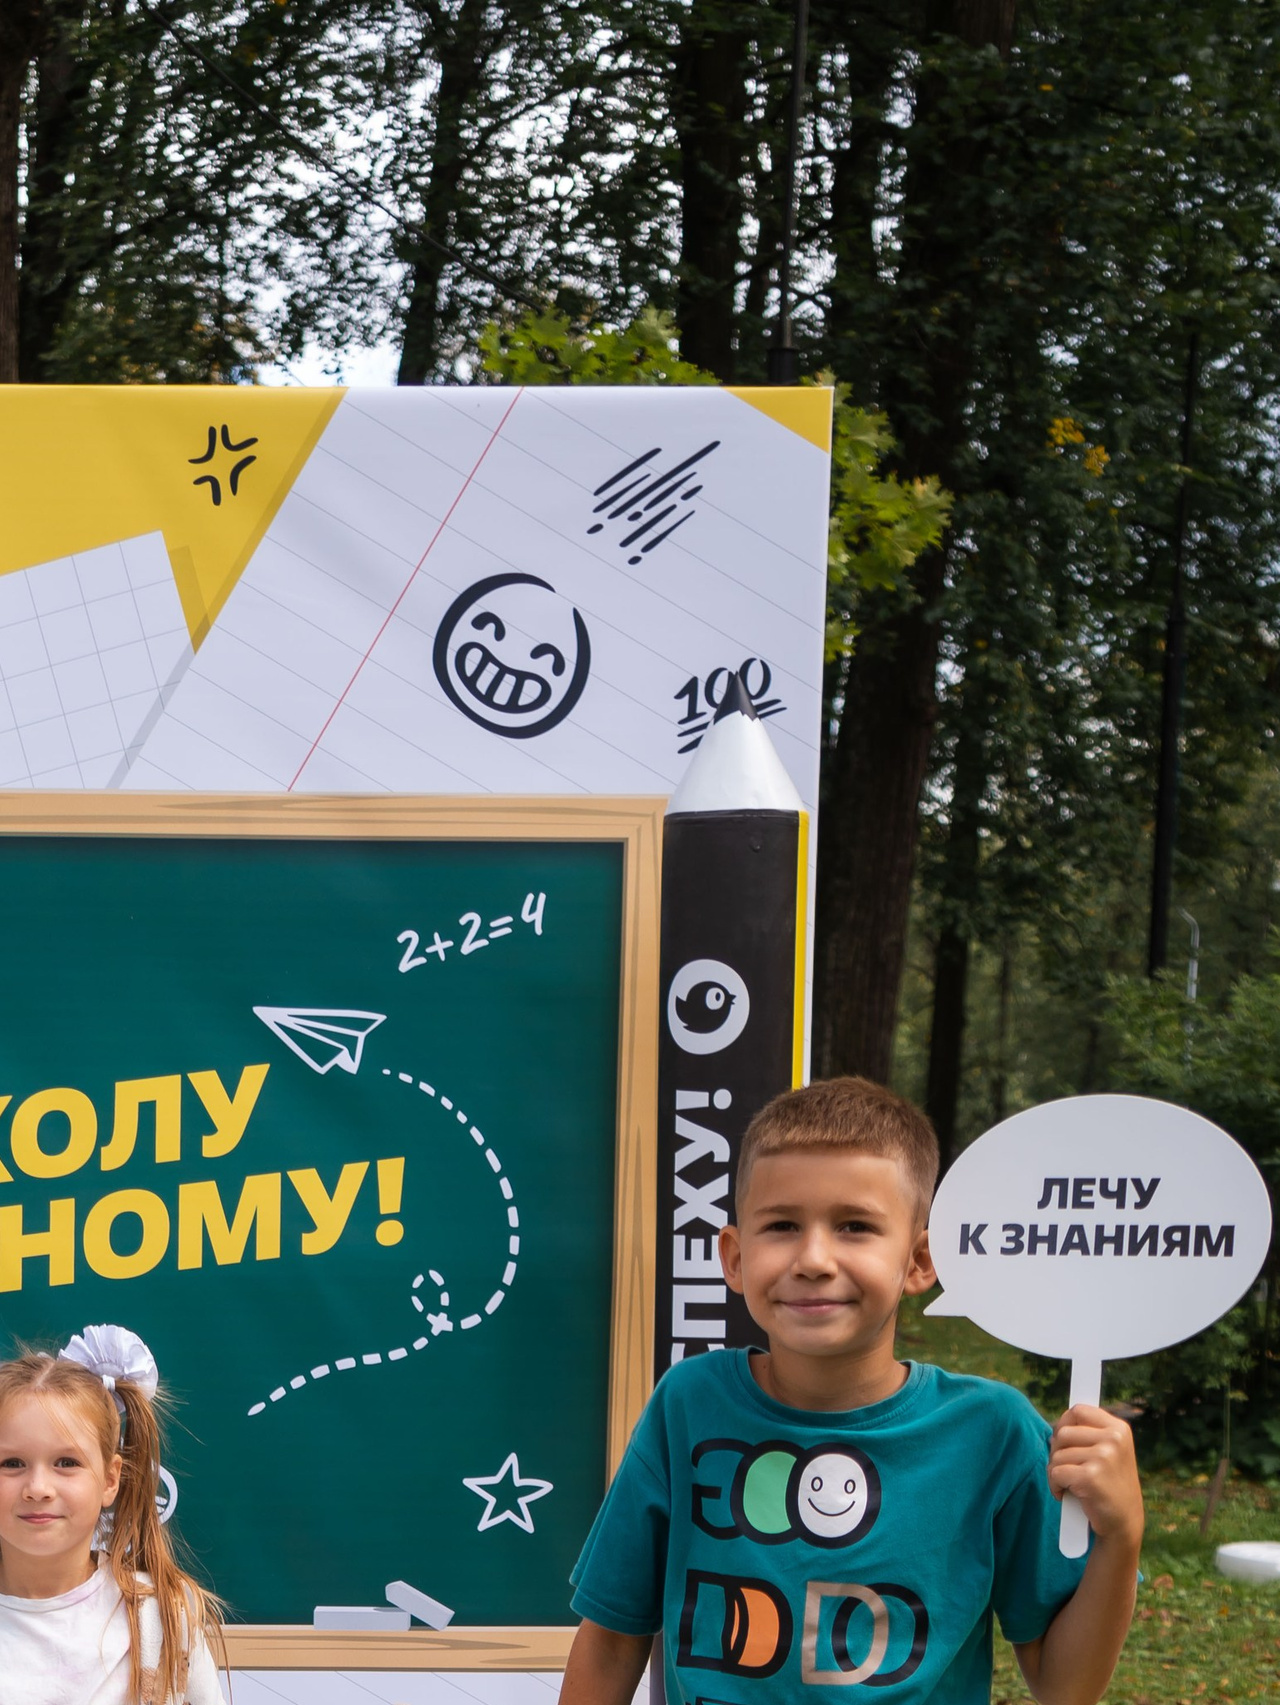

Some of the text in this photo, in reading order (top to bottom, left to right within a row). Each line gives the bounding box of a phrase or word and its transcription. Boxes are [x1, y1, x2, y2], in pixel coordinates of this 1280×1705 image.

[396, 892, 547, 973] 2+2=4
[1037, 1177, 1162, 1211] ЛЕЧУ
[959, 1223, 1236, 1259] К ЗНАНИЯМ
